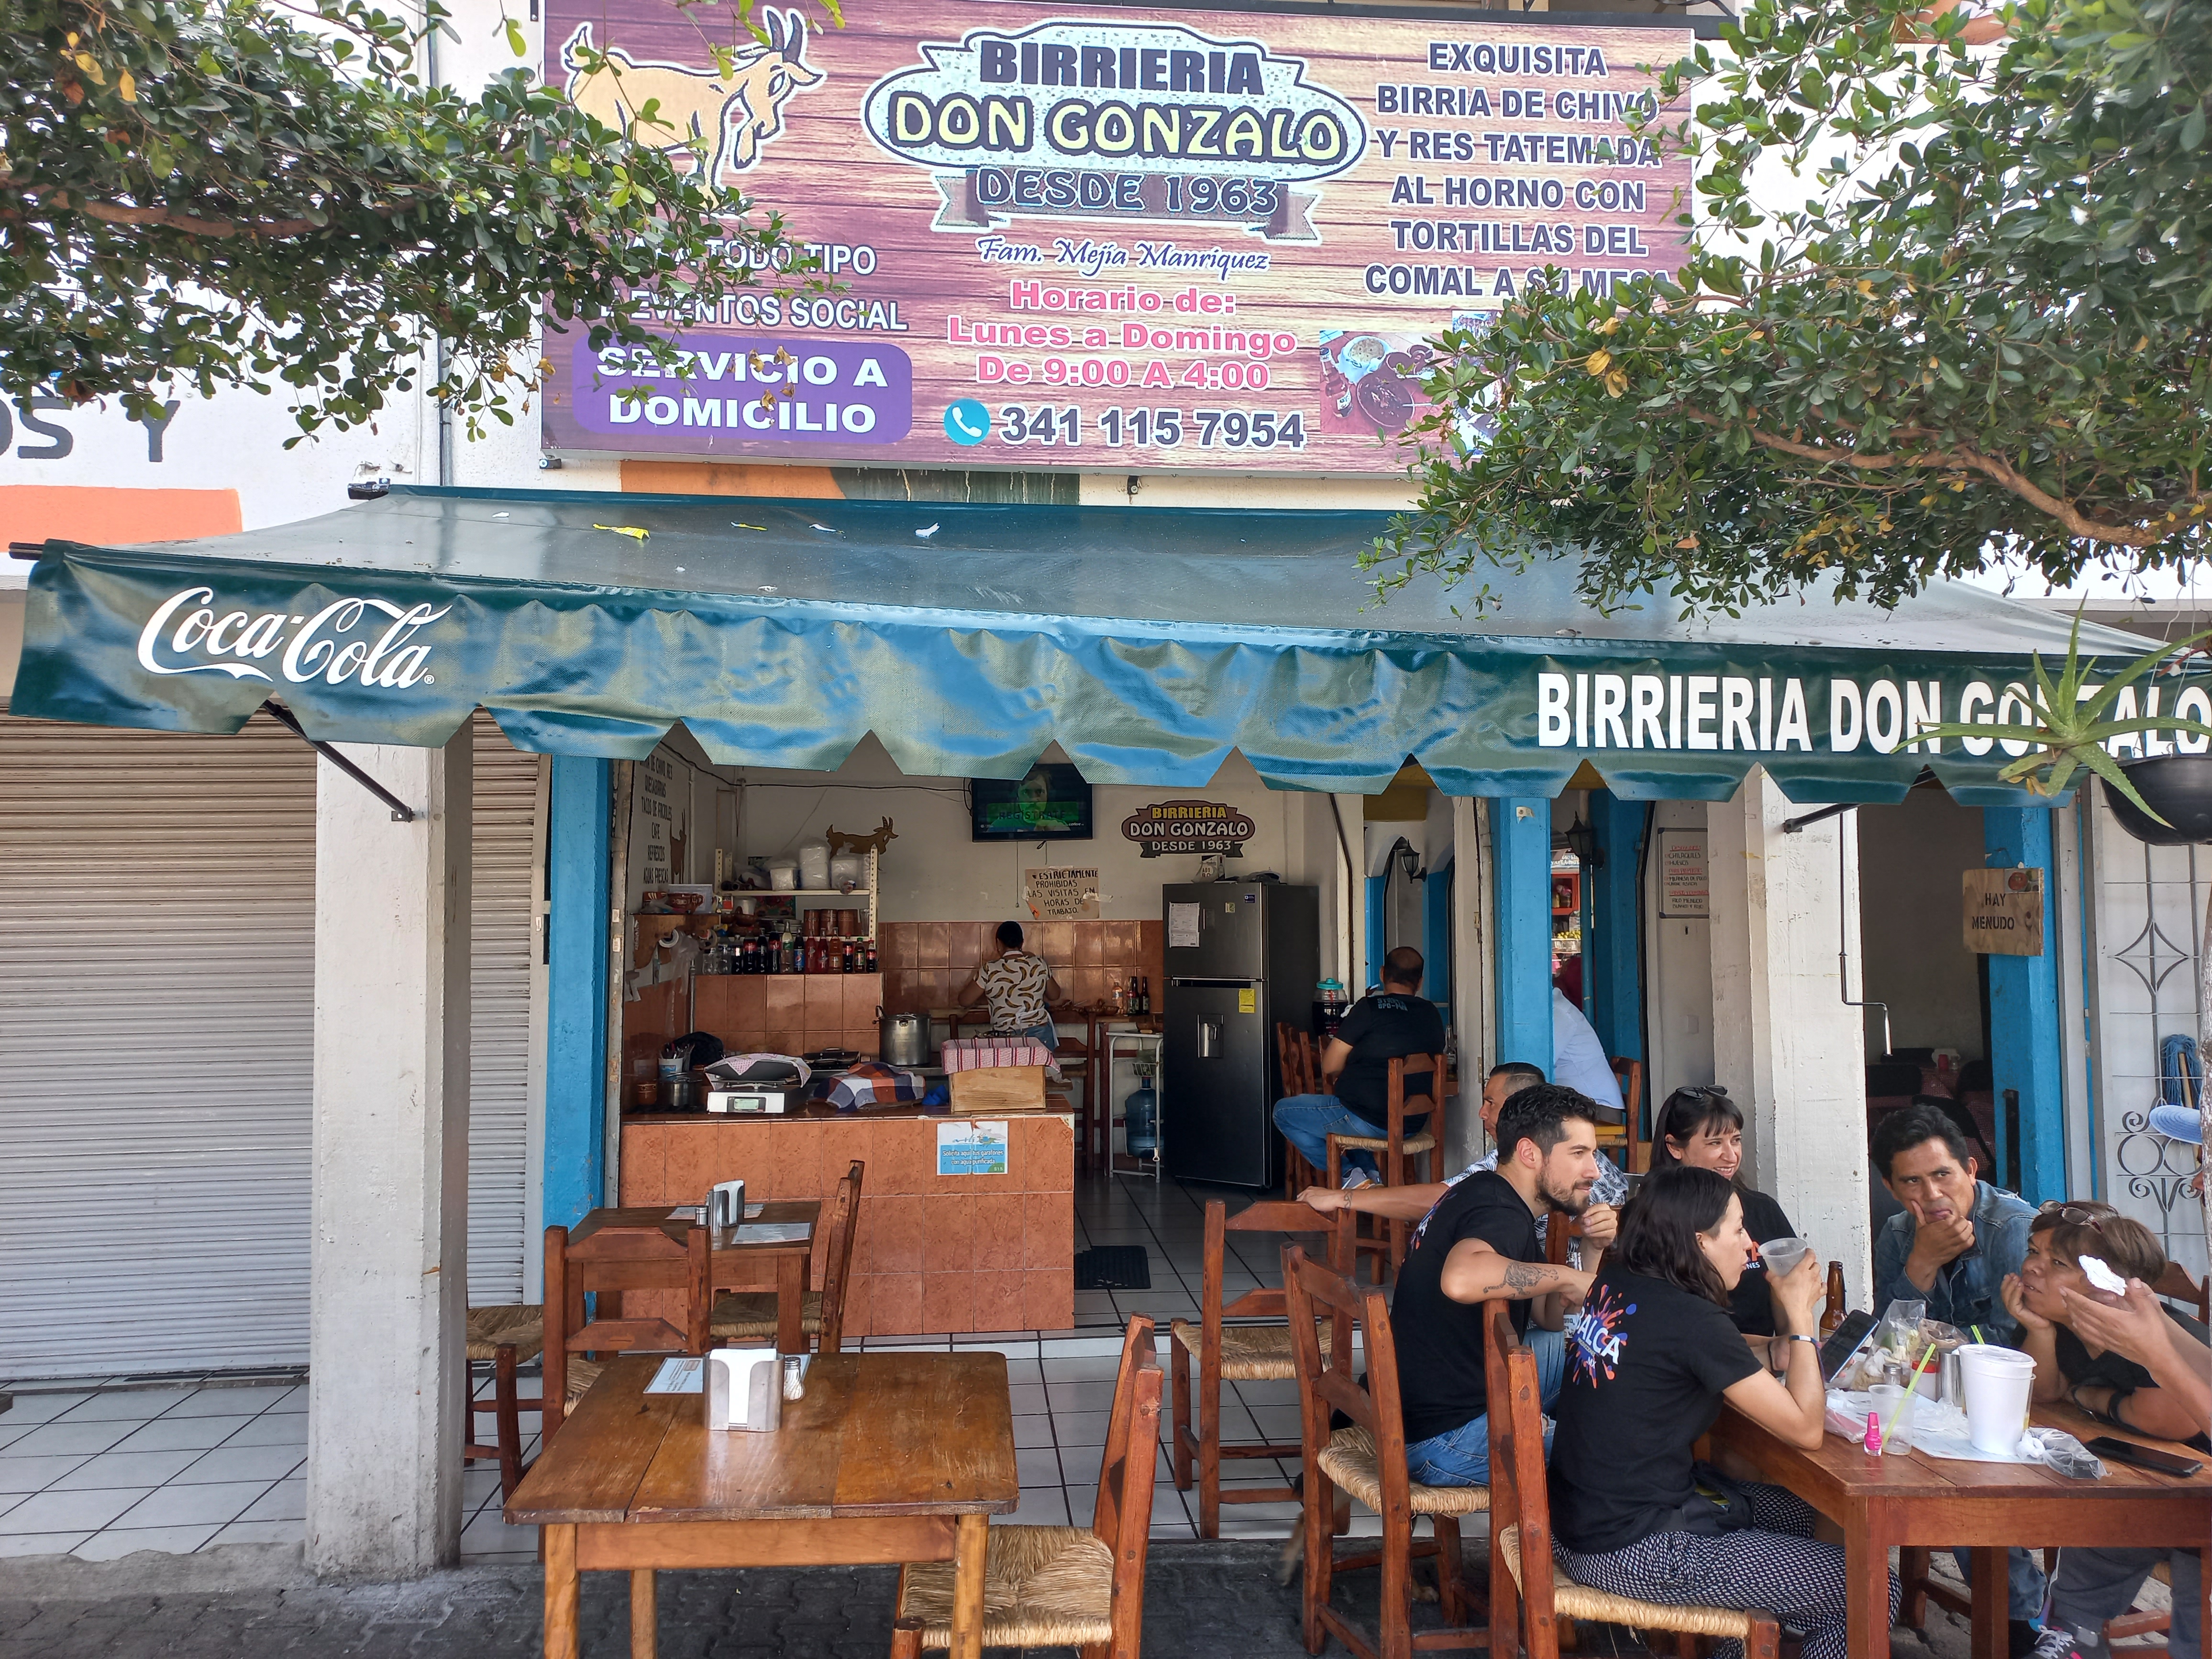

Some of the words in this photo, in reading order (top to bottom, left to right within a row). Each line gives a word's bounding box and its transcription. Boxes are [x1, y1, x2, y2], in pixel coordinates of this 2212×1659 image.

[980, 41, 1264, 95] BIRRIERIA
[1429, 42, 1606, 77] EXQUISITA
[1378, 85, 1491, 117] BIRRIA
[1502, 90, 1544, 118] DE
[1556, 92, 1659, 122] CHIVO
[891, 92, 1033, 151] DON
[1046, 100, 1347, 160] GONZALO
[1377, 131, 1398, 157] Y
[1410, 132, 1474, 161] RES
[1484, 134, 1660, 166] TATEMADA
[978, 169, 1145, 211] DESDE
[1165, 174, 1279, 215] 1963
[1392, 177, 1434, 205] AL
[1444, 178, 1564, 209] HORNO
[1576, 182, 1645, 210] CON
[1392, 221, 1574, 253] TORTILLAS
[1585, 226, 1648, 255] DEL
[705, 239, 793, 270] TODO
[804, 244, 877, 275] TIPO
[978, 238, 1043, 264] Fam.
[1055, 239, 1127, 276] Mejía
[1365, 265, 1482, 296] COMAL
[1494, 269, 1516, 296] A
[631, 290, 781, 326] EVENTOS
[790, 299, 908, 330] SOCIAL
[1012, 282, 1162, 312] Horario
[1175, 288, 1235, 314] de:
[950, 318, 1070, 346] Lunes
[1085, 327, 1107, 347] a
[1124, 324, 1297, 358] Domingo
[597, 346, 838, 385] SERVICIO
[853, 358, 887, 387] A
[979, 356, 1030, 383] De
[1044, 359, 1129, 386] 9:00
[1143, 362, 1174, 388] A
[1184, 363, 1270, 390] 4:00
[609, 394, 877, 433] DOMICILIO
[1002, 408, 1079, 443] 341
[1101, 410, 1181, 445] 115
[1196, 412, 1305, 448] 7954
[1537, 673, 1812, 752] BIRRIERIA
[1830, 679, 1941, 754] DON
[1130, 822, 1165, 836] DON
[1170, 822, 1249, 836] GONZALO
[1152, 806, 1228, 818] BIRRIERIA
[1152, 841, 1195, 851] DESDE
[1202, 840, 1231, 850] 1963
[1036, 880, 1078, 888] PROHIBIDAS
[1039, 870, 1098, 879] ESTRICTAMENTE
[1028, 890, 1043, 898] LAS
[1048, 888, 1079, 897] VISITAS
[1043, 898, 1069, 907] HORAS
[1985, 893, 2006, 907] HAY
[1972, 916, 2015, 930] MENUDO
